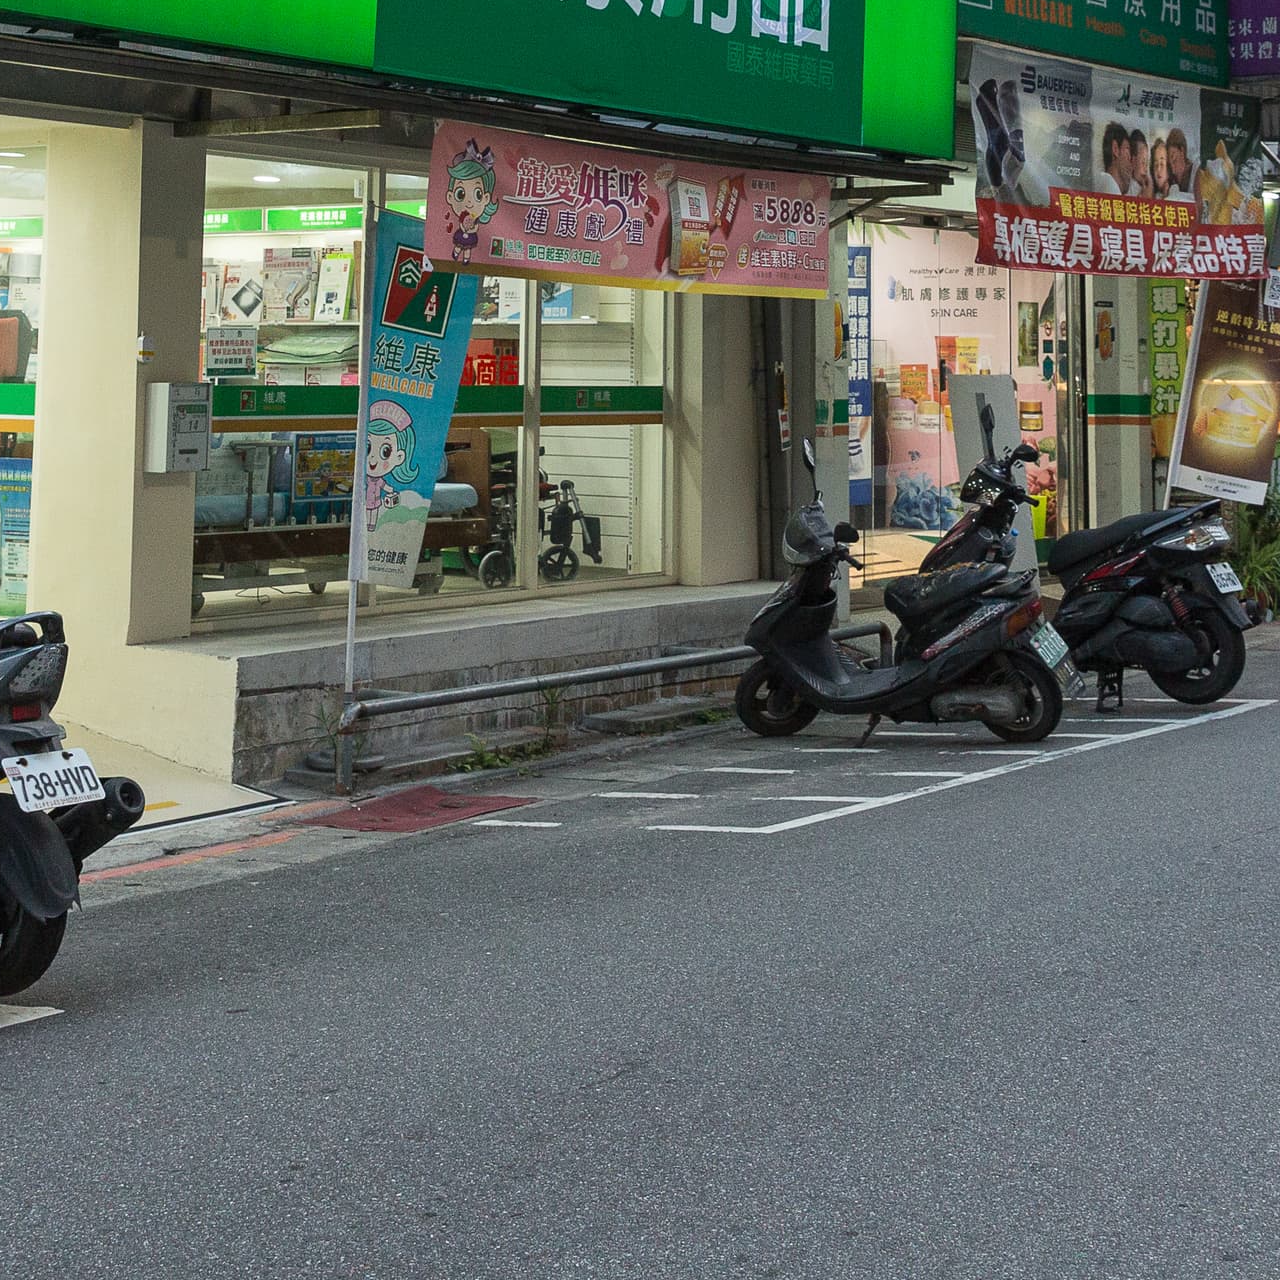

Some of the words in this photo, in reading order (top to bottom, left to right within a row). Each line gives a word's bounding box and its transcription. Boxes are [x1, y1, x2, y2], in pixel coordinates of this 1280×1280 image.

[1036, 74, 1087, 98] BAUERFEIND
[517, 157, 649, 211] 寵愛媽咪
[523, 206, 645, 246] 健康獻禮
[993, 214, 1094, 269] 專櫃護具
[901, 287, 1007, 302] 肌膚修護專家
[953, 308, 978, 318] CARE
[373, 333, 442, 382] 維康
[1152, 285, 1181, 414] 現打果汁
[370, 372, 435, 400] WELLCARE
